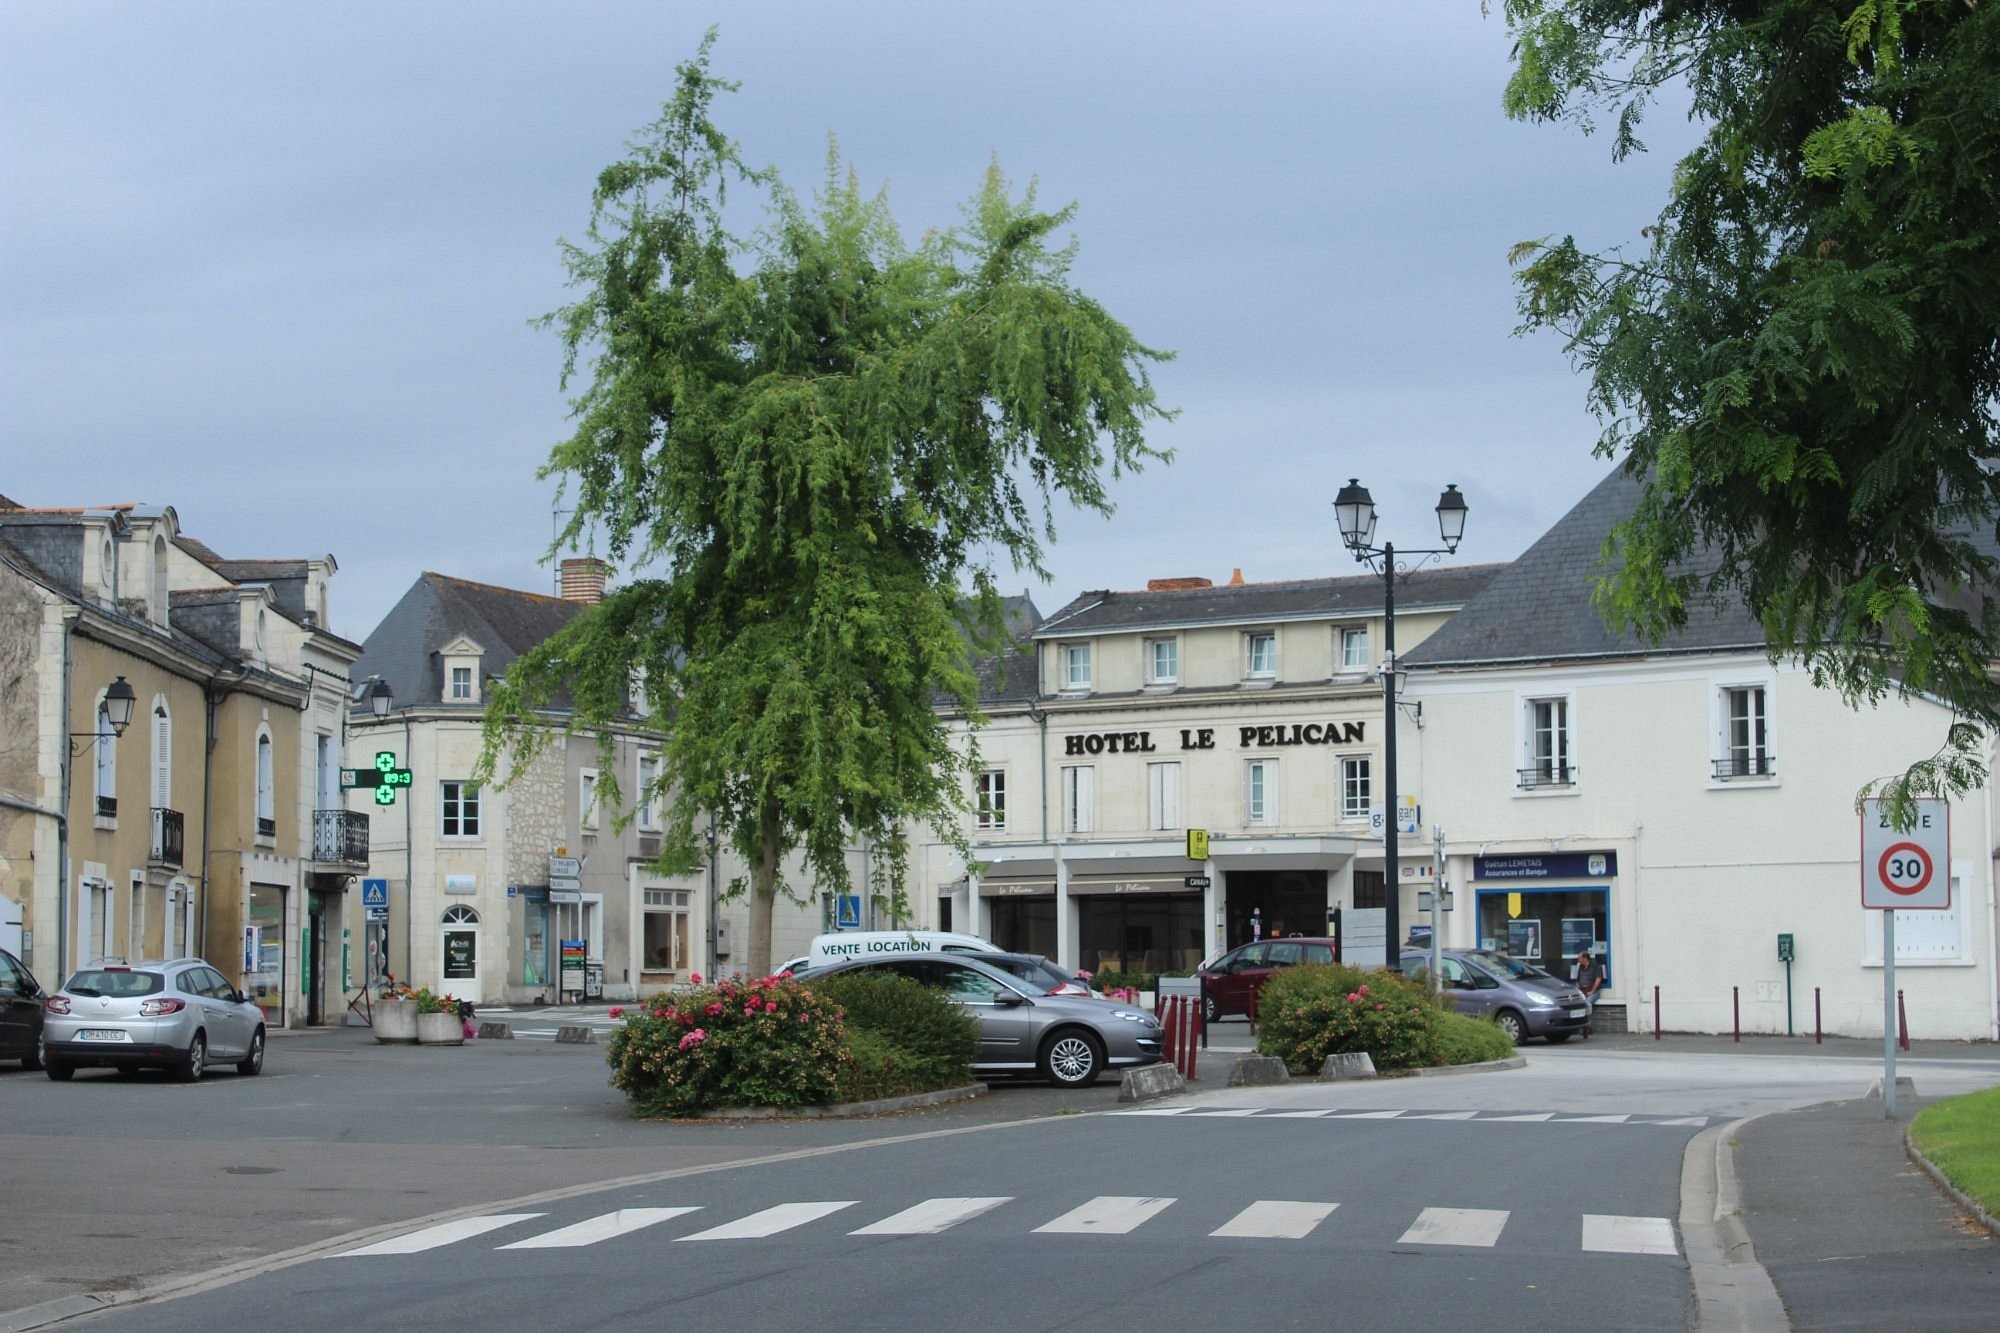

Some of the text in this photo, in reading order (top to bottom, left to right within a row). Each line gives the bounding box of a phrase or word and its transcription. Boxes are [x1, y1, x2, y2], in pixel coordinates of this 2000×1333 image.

[1065, 721, 1366, 755] HOTEL LE PELICAN
[1399, 807, 1415, 821] gan
[1880, 814, 1931, 828] ZE
[1485, 869, 1518, 877] Assurances
[1525, 868, 1548, 877] Banque
[1891, 859, 1921, 879] 30
[822, 941, 931, 955] VENTE LOCATION
